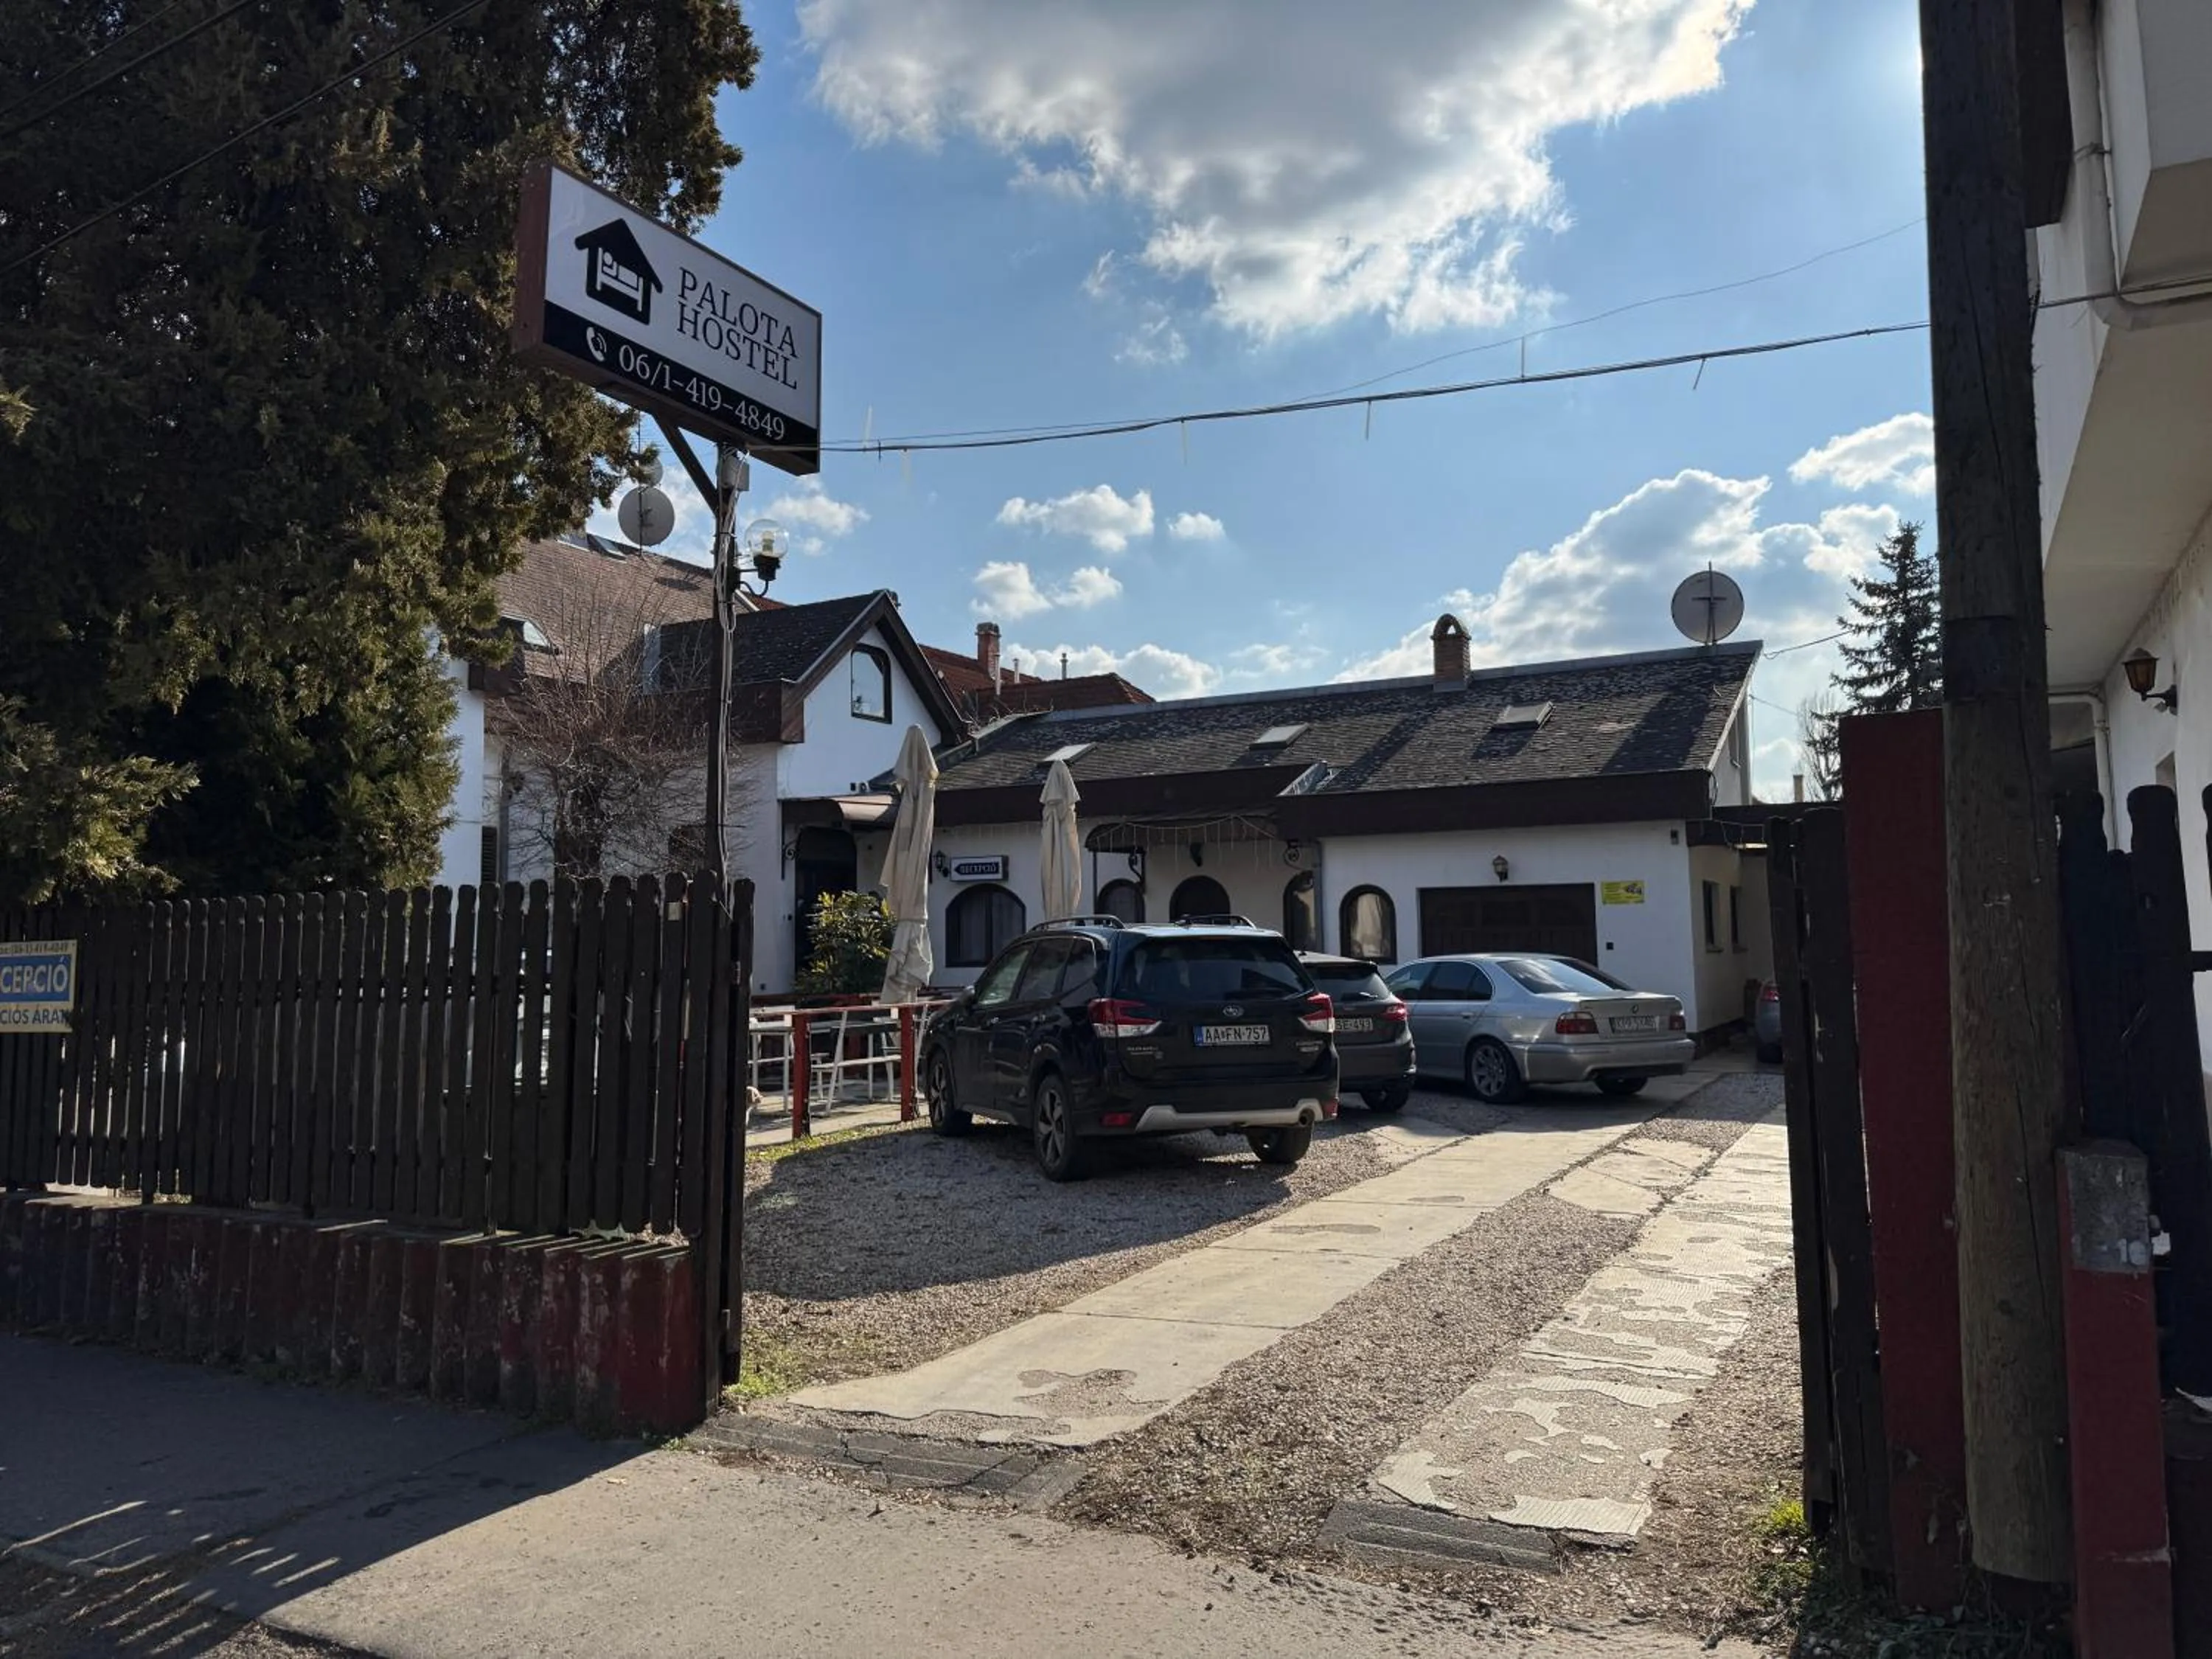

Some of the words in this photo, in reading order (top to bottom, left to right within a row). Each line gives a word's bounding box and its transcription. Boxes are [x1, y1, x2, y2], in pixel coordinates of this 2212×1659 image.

[676, 301, 798, 390] HOSTEL
[678, 266, 800, 359] PALOTA
[618, 344, 785, 441] 06/1-419-4849
[1, 955, 69, 993] CEPCIÓ
